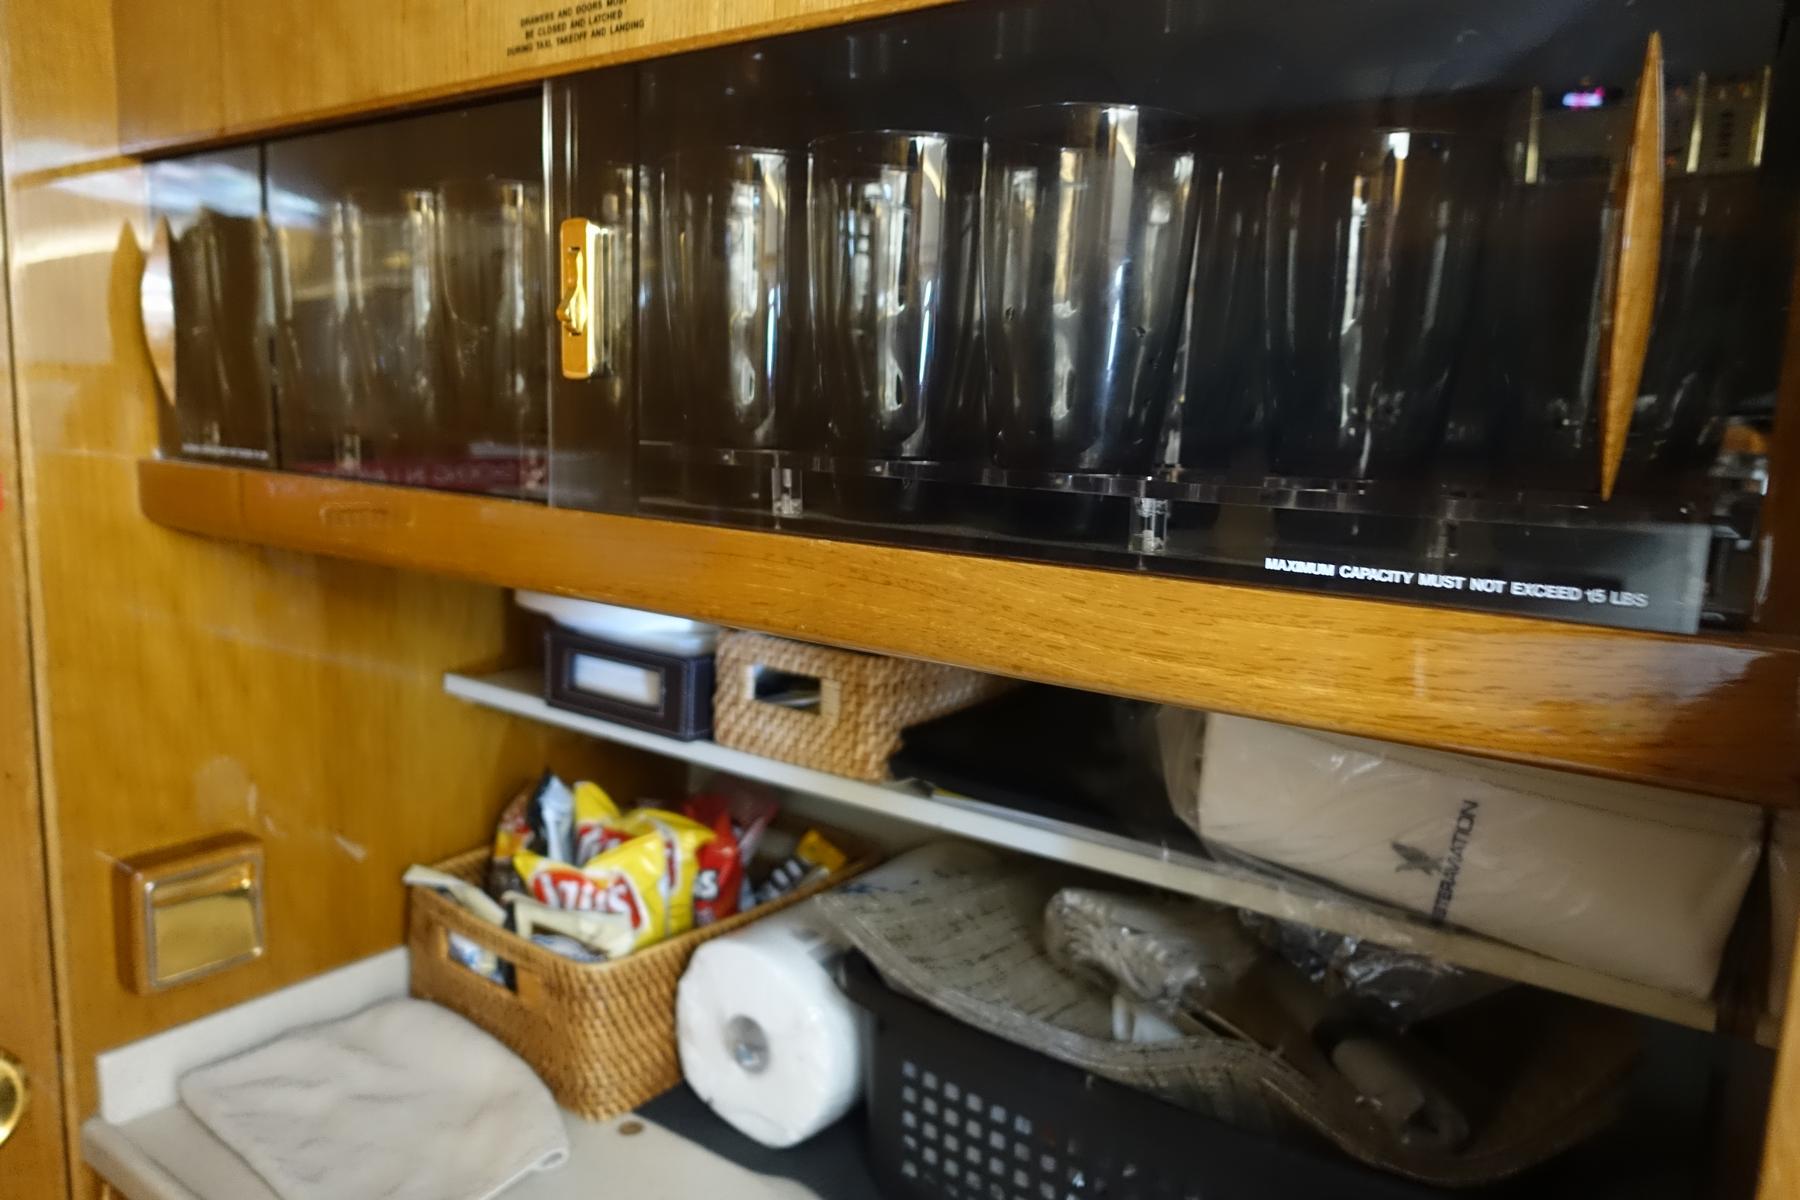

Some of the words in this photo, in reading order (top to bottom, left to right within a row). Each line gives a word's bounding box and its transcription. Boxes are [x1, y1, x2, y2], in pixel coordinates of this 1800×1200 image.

[520, 12, 554, 27] DRAWERS
[558, 8, 573, 19] AND
[576, 2, 603, 14] DOORS
[525, 30, 535, 40] BE
[537, 22, 567, 36] CLOSED
[570, 18, 586, 29] AND
[588, 10, 623, 26] LATCHED
[506, 44, 533, 57] DURING
[556, 32, 588, 47] TAKEOFF
[591, 27, 606, 38] AND
[609, 19, 645, 35] LANDING
[1264, 557, 1335, 576] MAXIMUM
[1338, 564, 1415, 584] CAPACITY
[1418, 572, 1466, 590] MUST
[1469, 577, 1507, 593] NOT
[1510, 581, 1582, 601] EXCEED
[1584, 589, 1607, 603] 15
[1609, 590, 1649, 607] LBS
